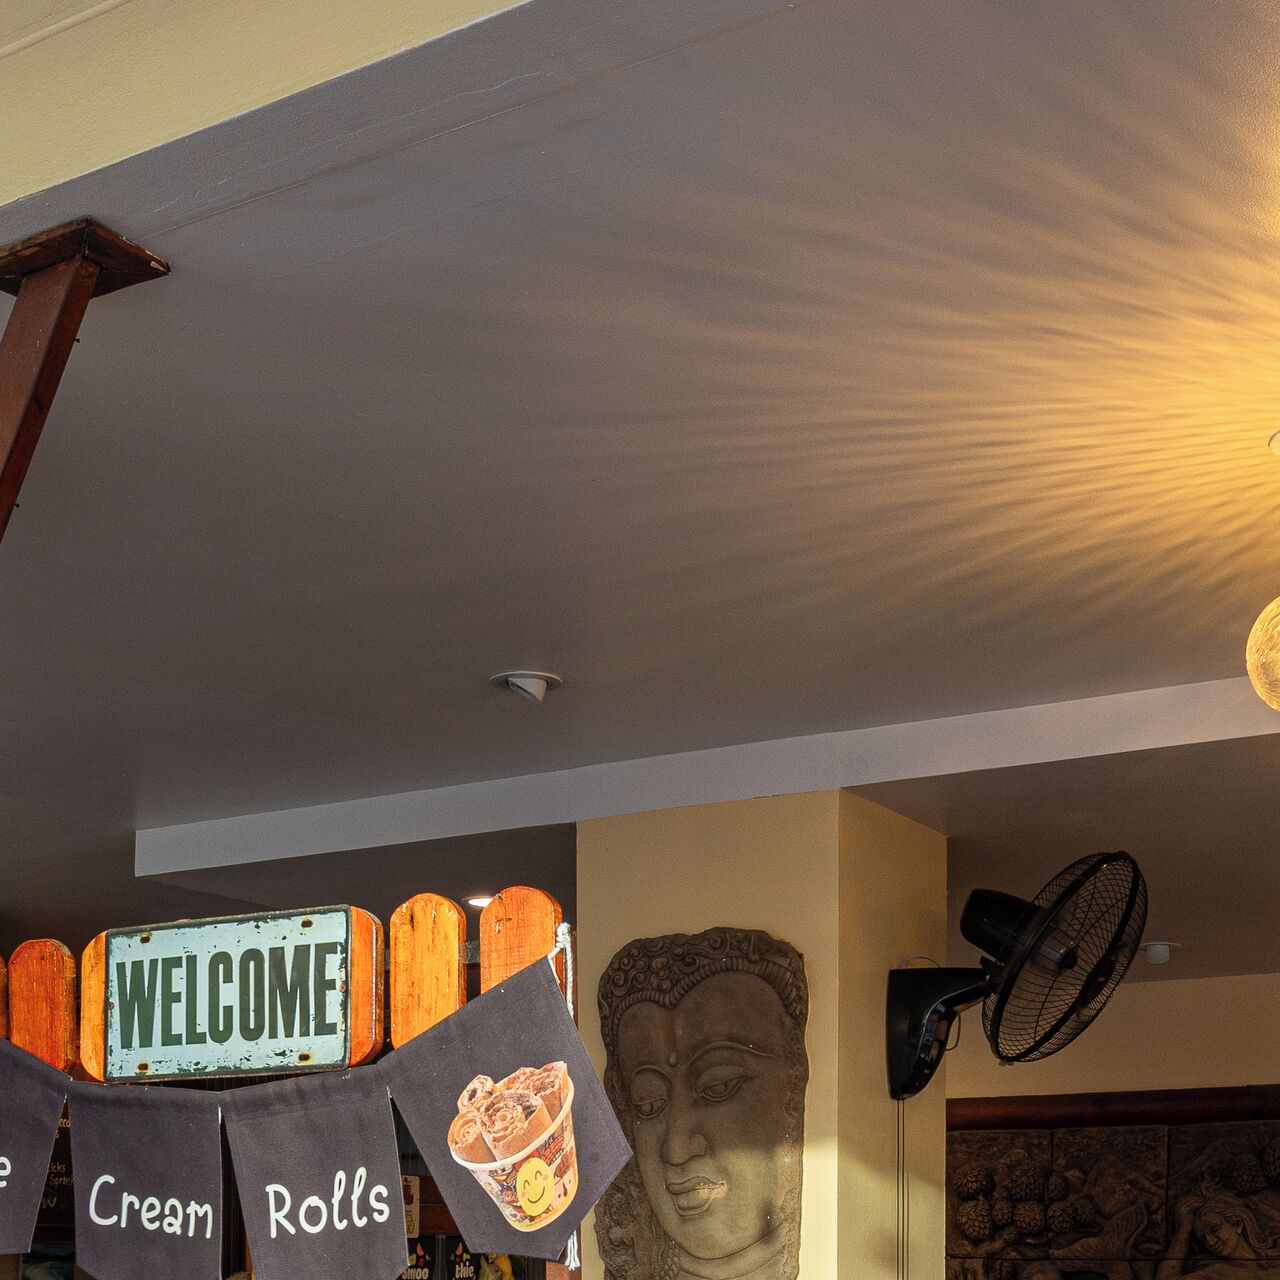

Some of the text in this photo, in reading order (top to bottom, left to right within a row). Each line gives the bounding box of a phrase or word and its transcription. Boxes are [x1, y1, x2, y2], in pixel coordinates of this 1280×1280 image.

[116, 943, 340, 1049] WELCOME
[89, 1173, 214, 1240] Cream
[264, 1165, 390, 1240] Rolls
